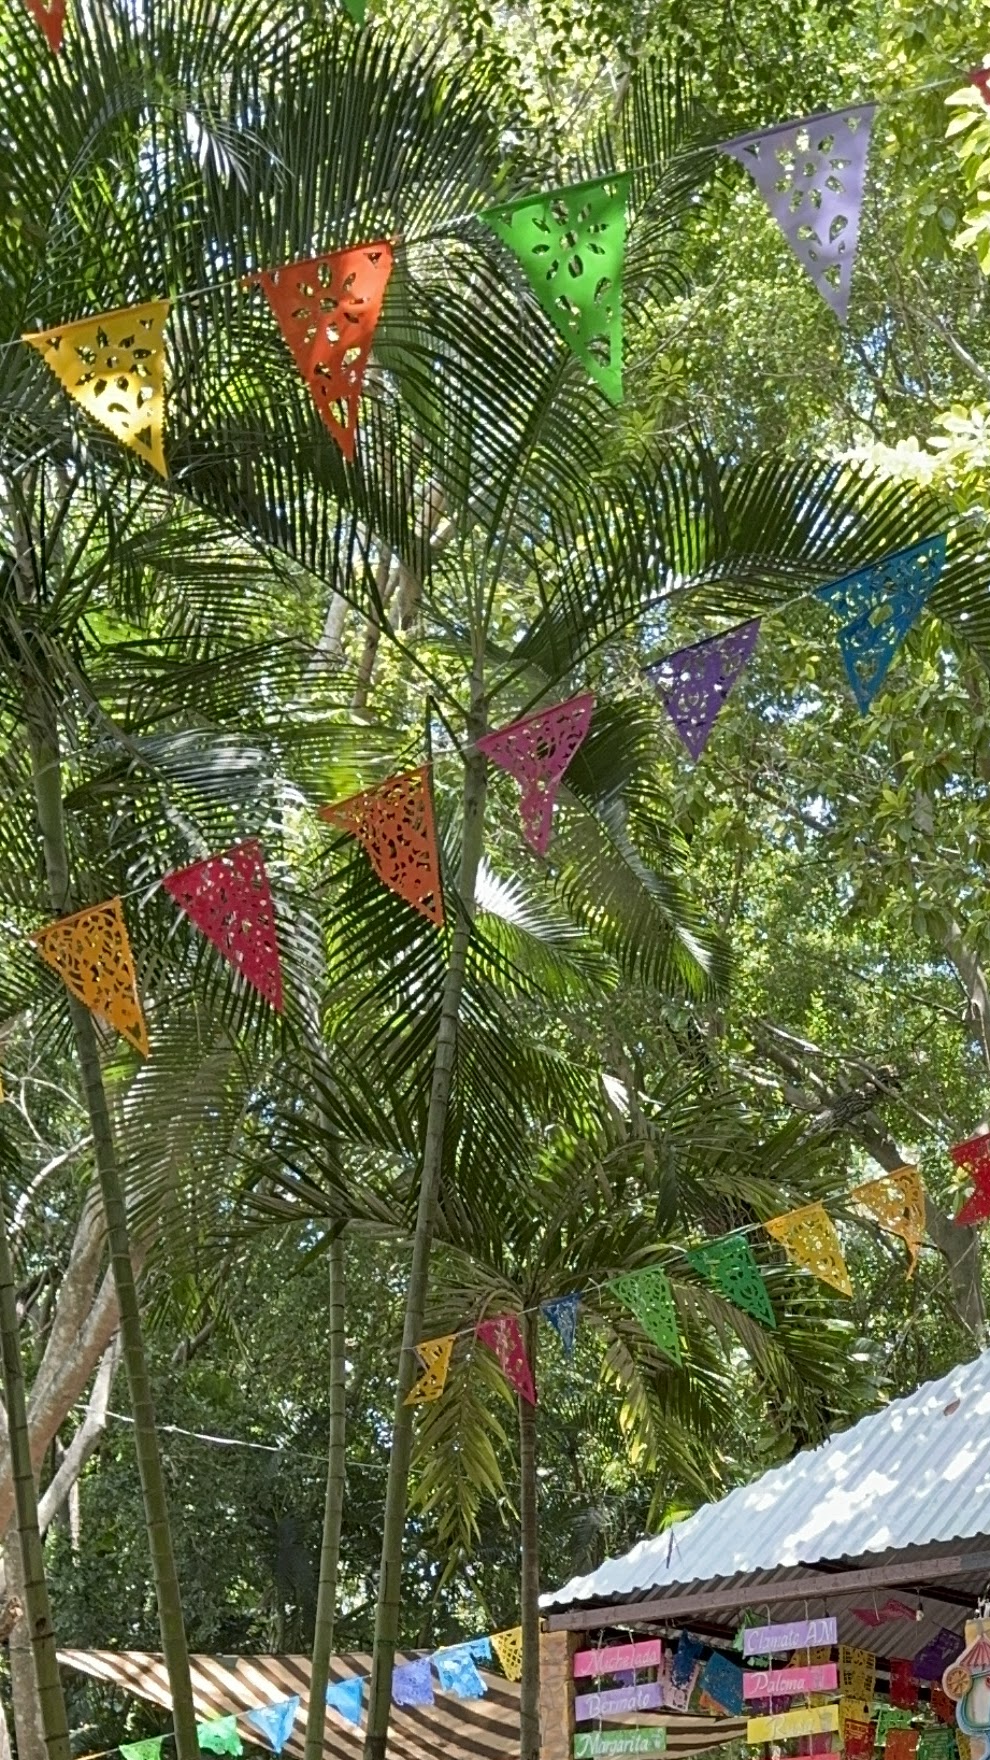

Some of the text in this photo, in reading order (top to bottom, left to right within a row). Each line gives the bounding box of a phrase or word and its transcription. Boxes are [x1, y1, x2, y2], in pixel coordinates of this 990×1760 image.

[747, 1628, 800, 1652] Clamato
[581, 1646, 658, 1674] Michelada
[750, 1672, 805, 1695] Paloma
[576, 1732, 650, 1757] Margarita
